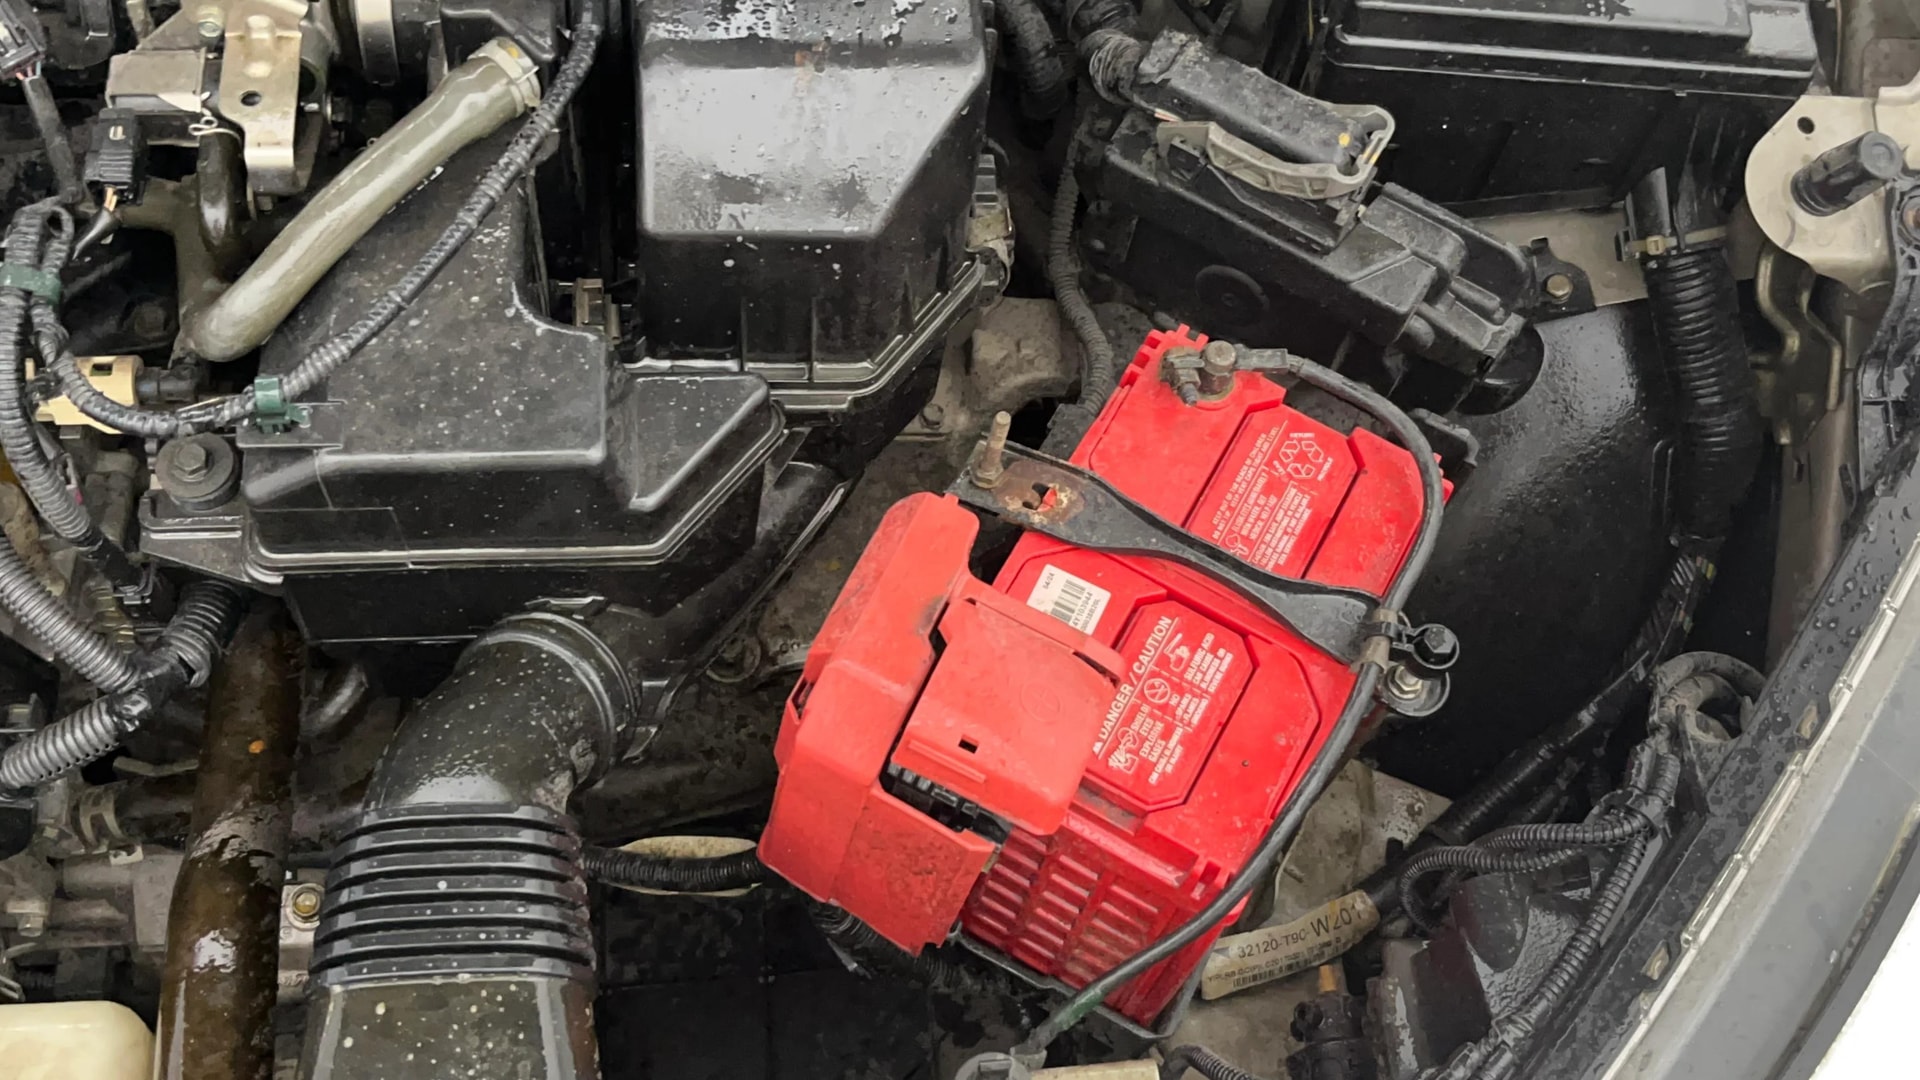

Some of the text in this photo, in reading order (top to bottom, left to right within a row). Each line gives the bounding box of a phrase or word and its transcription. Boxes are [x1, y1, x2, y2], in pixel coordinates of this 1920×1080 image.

[1234, 464, 1249, 483] REACH
[1183, 631, 1215, 681] SULFURIC ACID
[1098, 682, 1134, 739] DANGER
[1131, 614, 1172, 674] CAUTION
[1168, 692, 1180, 706] NO
[1139, 716, 1154, 736] EYES
[1139, 720, 1164, 757] EXPLOSIVE
[1147, 737, 1166, 762] GASES
